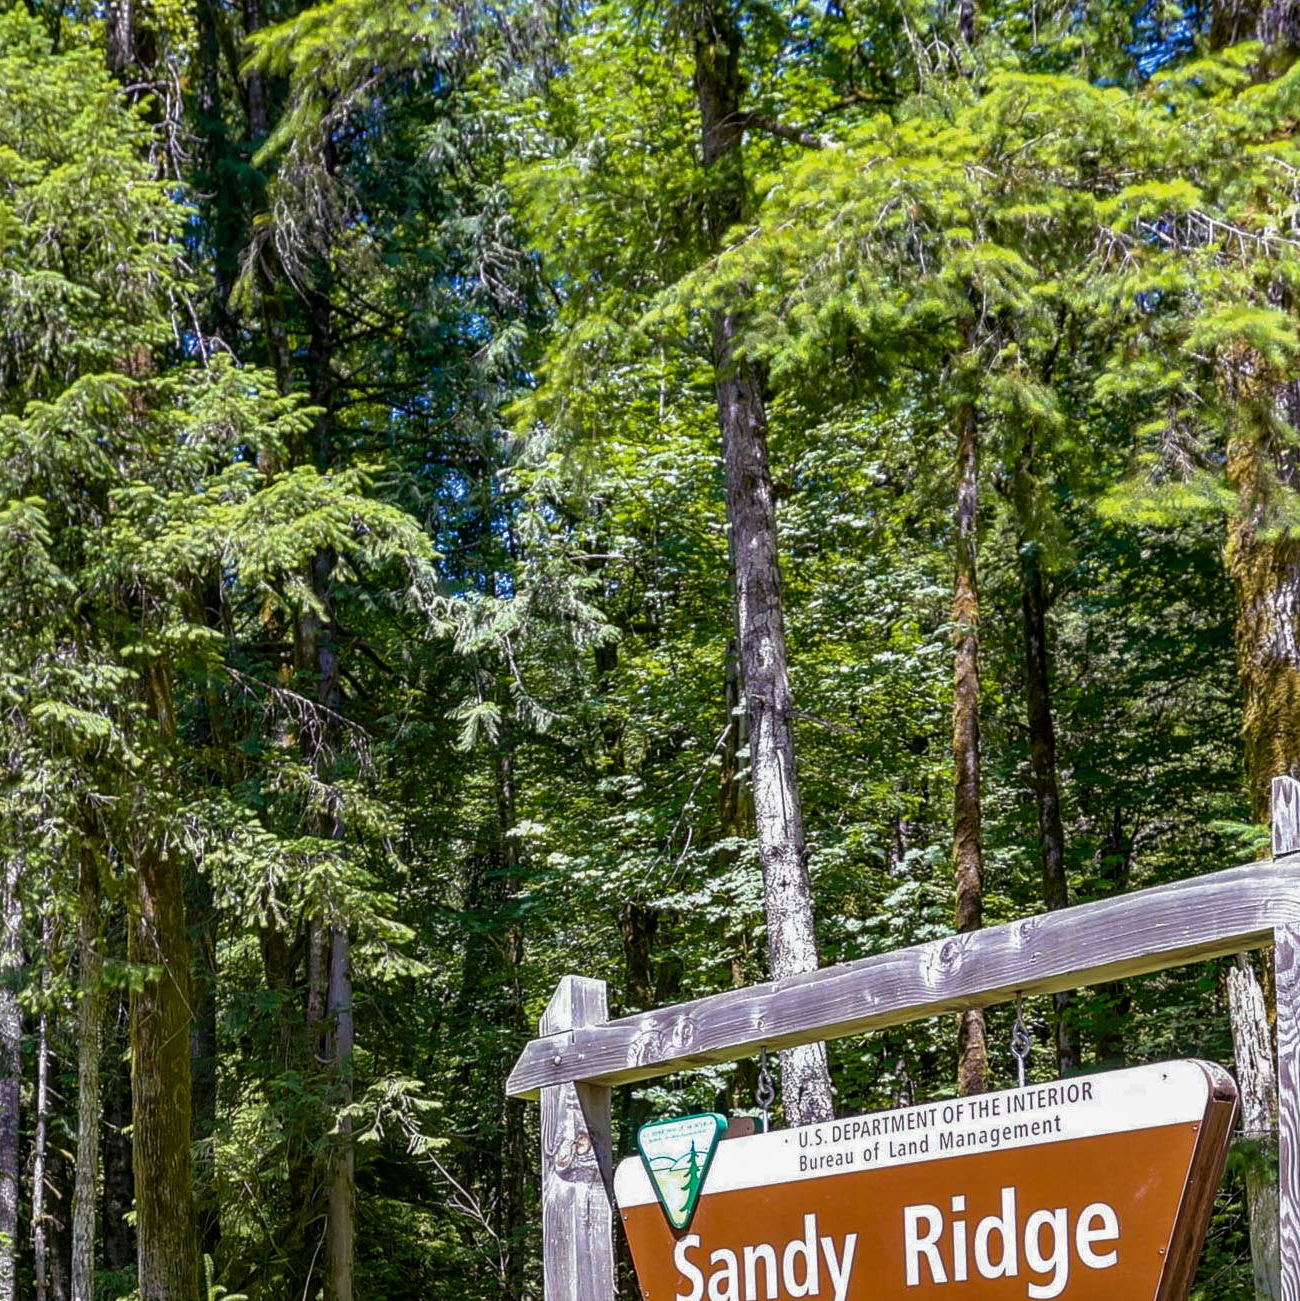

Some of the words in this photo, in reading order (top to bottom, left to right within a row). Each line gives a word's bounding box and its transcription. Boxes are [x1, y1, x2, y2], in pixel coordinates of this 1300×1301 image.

[799, 1128, 827, 1148] U.S.
[832, 1109, 937, 1142] DEPARTMENT
[943, 1104, 964, 1124] OF
[969, 1098, 1000, 1120] THE
[1007, 1081, 1093, 1114] INTERIOR
[800, 1151, 854, 1172] Bureau
[863, 1142, 880, 1162] of
[890, 1134, 929, 1158] Land
[940, 1115, 1062, 1150] Management
[903, 1187, 1120, 1299] Ridge
